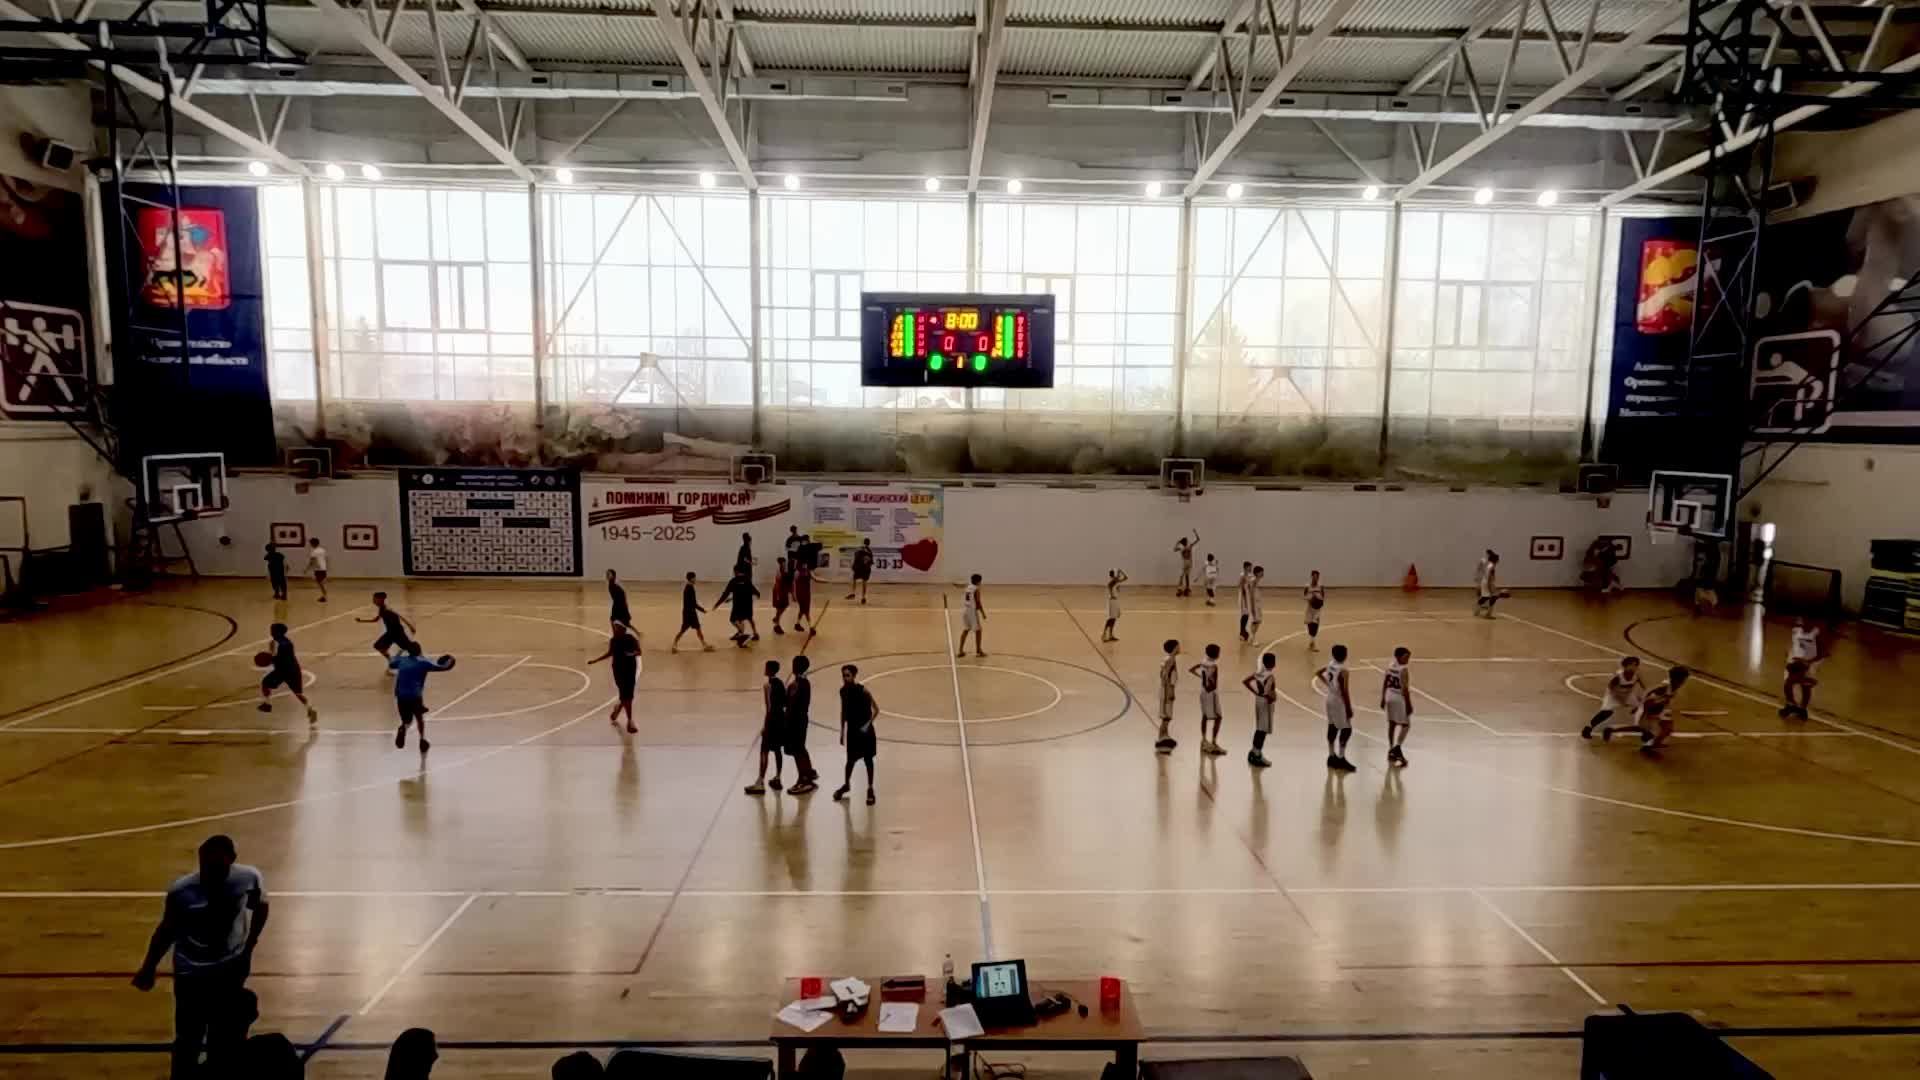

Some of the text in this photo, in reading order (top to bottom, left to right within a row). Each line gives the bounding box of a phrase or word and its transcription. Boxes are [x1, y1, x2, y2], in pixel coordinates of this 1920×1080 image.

[944, 313, 978, 329] 8:00
[944, 336, 987, 351] 0 0
[606, 491, 750, 505] ПОМНИМ! ГОРДИМСЯ!
